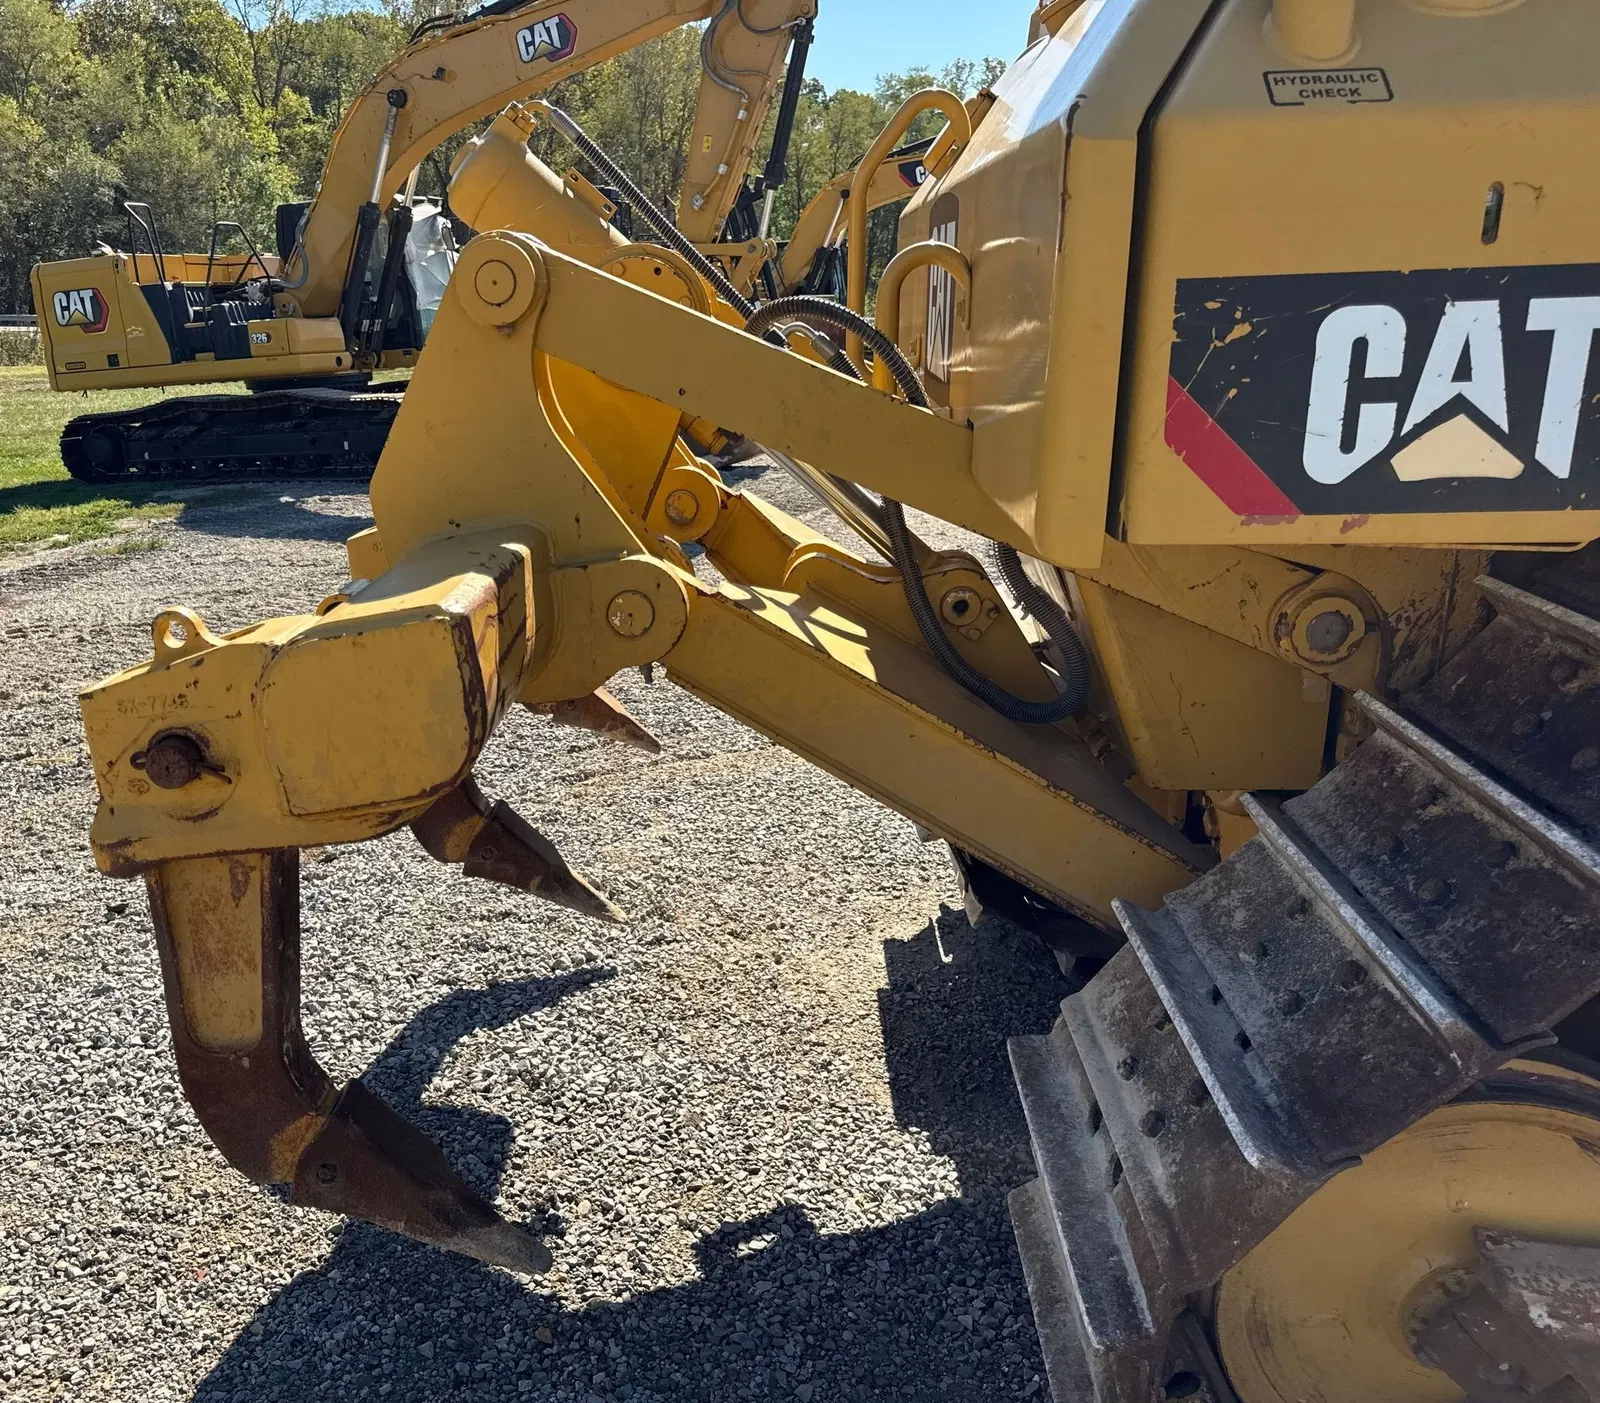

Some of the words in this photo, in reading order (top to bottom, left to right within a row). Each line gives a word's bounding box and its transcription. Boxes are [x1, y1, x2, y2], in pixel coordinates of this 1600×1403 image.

[516, 15, 562, 62] CAT
[1273, 73, 1379, 87] HYDRAULIC
[1298, 87, 1361, 99] CHECK
[53, 289, 95, 326] CAT
[251, 333, 268, 344] 326
[1302, 296, 1600, 485] CAT
